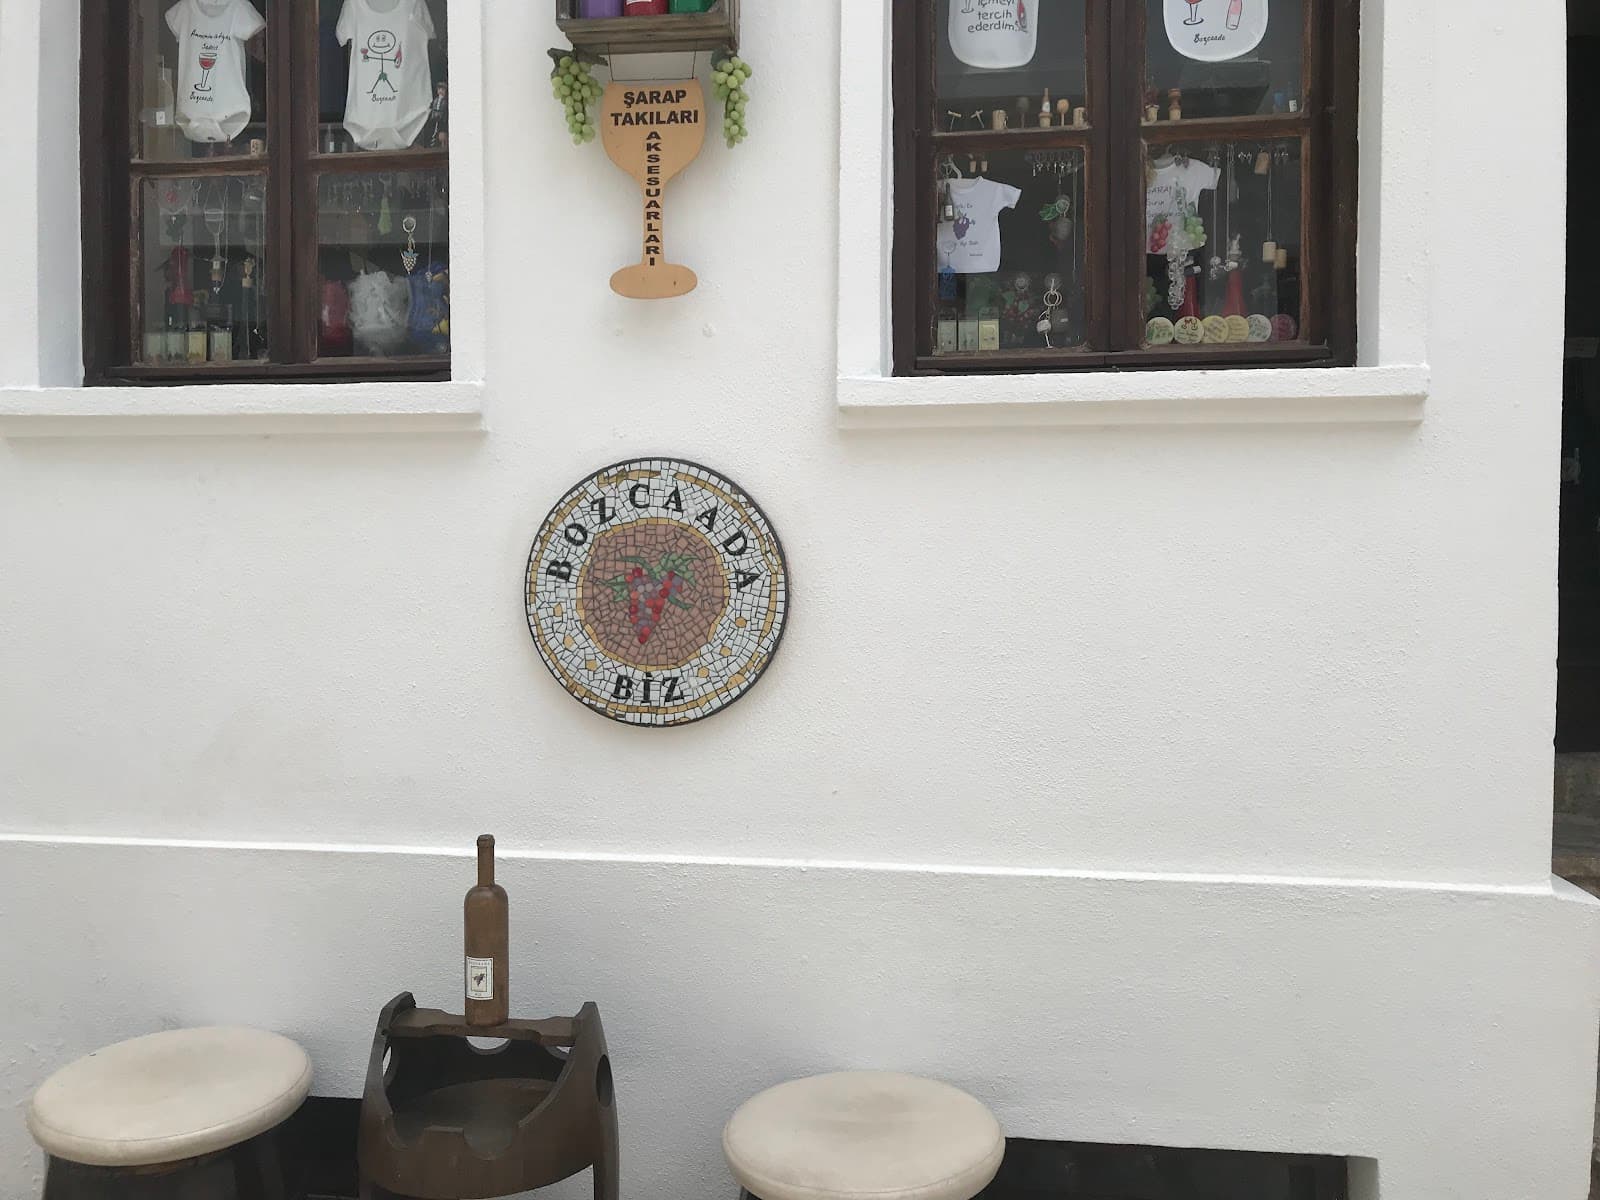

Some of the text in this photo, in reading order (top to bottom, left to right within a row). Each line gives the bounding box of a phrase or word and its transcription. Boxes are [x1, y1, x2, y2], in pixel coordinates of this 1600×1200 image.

[977, 9, 1013, 20] tercih
[623, 89, 687, 108] ŞARAP
[610, 109, 699, 126] TAKILARI
[645, 131, 662, 266] AKSESUARLARI
[545, 483, 761, 591] BOZCAADA
